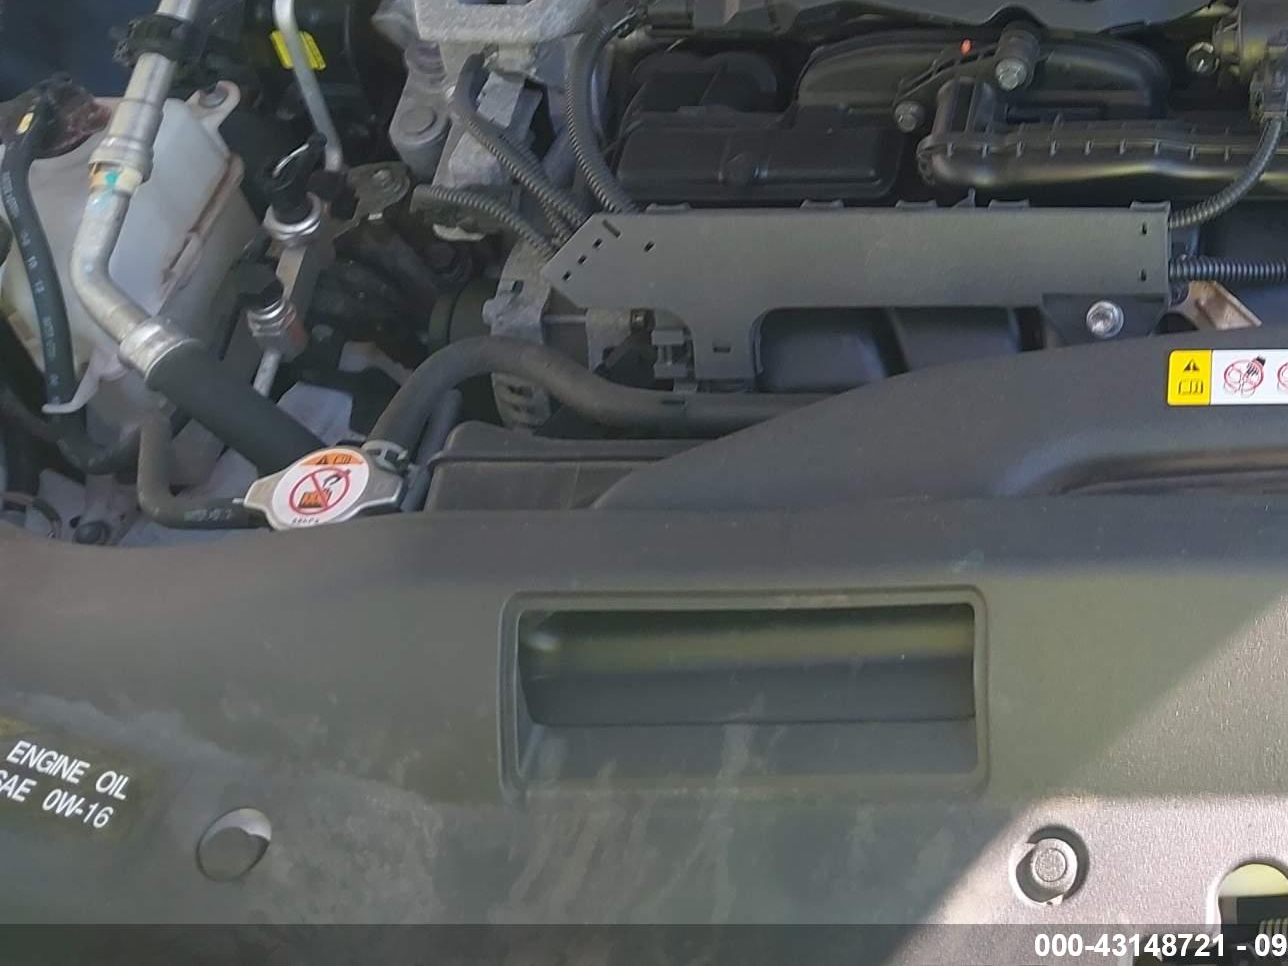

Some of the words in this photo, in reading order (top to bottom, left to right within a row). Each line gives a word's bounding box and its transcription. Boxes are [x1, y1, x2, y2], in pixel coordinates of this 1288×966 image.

[6, 739, 91, 784] ENGINE
[95, 770, 129, 801] OIL
[42, 788, 114, 829] 0W-16
